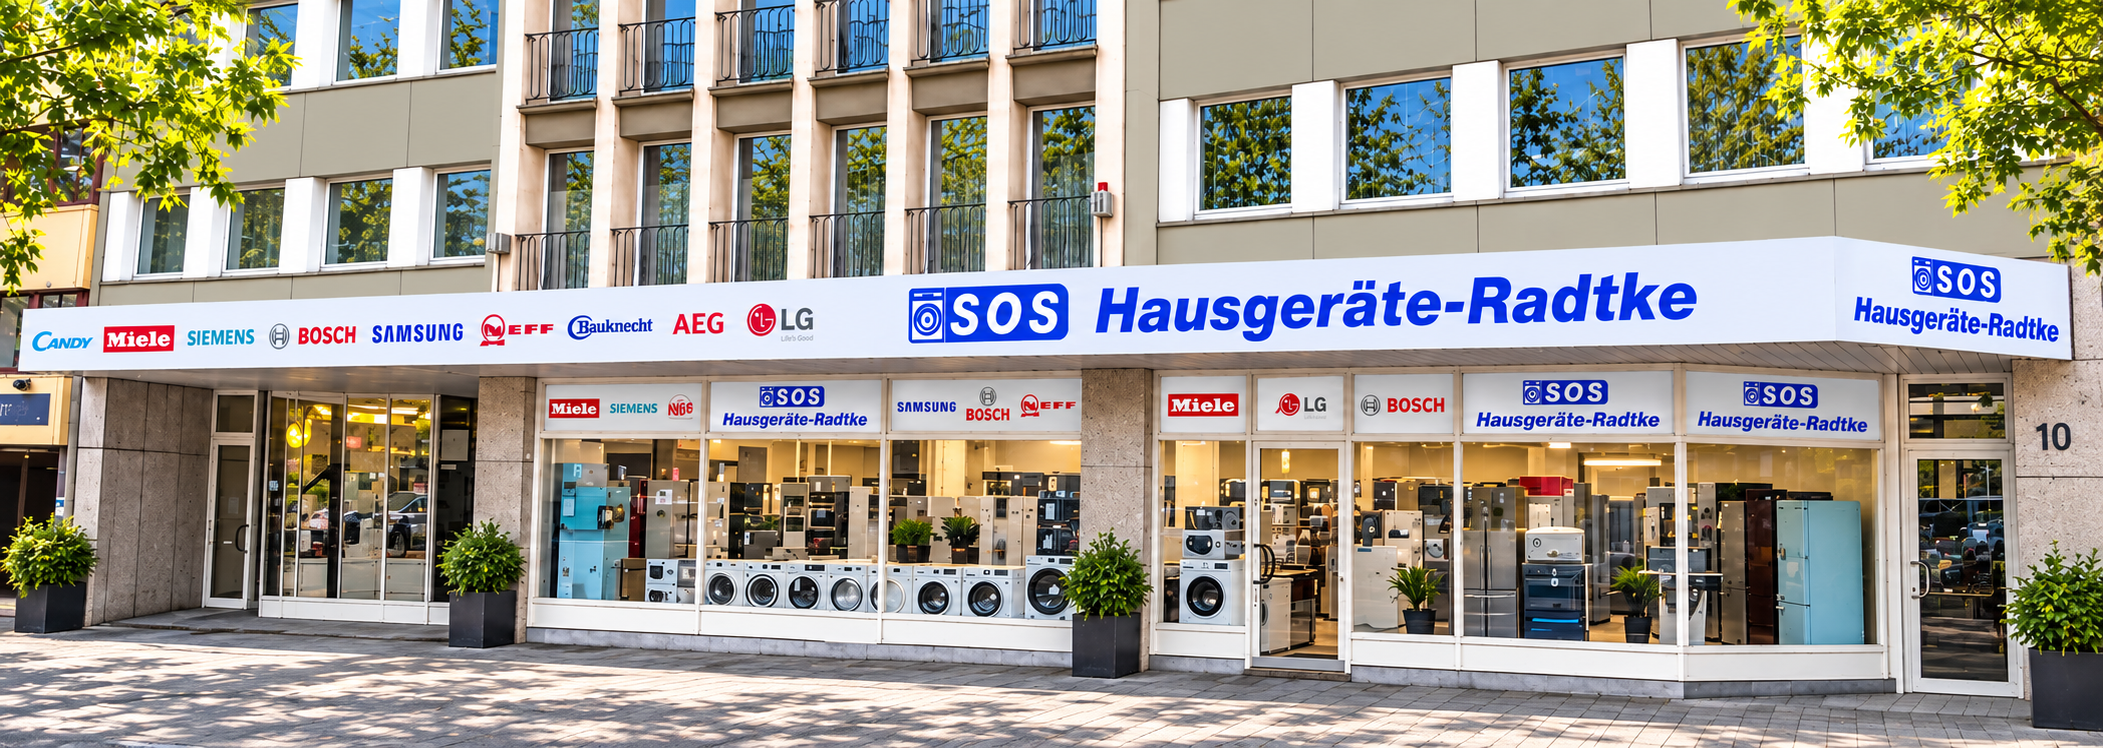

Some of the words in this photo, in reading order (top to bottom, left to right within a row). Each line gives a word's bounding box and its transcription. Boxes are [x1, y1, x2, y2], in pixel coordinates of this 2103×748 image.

[1937, 264, 1996, 299] SOS
[951, 290, 1059, 336] SOS
[1095, 272, 1698, 342] Hausgeräte-Radtke
[569, 316, 653, 338] Bauknecht
[672, 312, 725, 335] AEG
[781, 307, 814, 331] LG
[1854, 296, 2060, 343] Hausgeräte-Radtke
[107, 330, 171, 348] Miele
[187, 329, 255, 346] SIEMENS
[298, 326, 356, 345] BOSCH
[372, 323, 464, 343] SAMSUNG
[777, 387, 820, 406] SOS
[1545, 382, 1603, 403] SOS
[1762, 384, 1814, 406] SOS
[551, 402, 597, 415] Miele
[610, 403, 658, 414] SIEMENS
[897, 401, 957, 413] SAMSUNG
[1171, 398, 1235, 413] Miele
[1304, 396, 1327, 412] LG
[1387, 397, 1445, 413] BOSCH
[722, 411, 868, 430] Hausgeräte-Radtke
[966, 408, 1010, 421] BOSCH
[1476, 411, 1660, 431] Hausgeräte-Radtke
[1697, 410, 1868, 434] Hausgeräte-Radtke
[2036, 422, 2072, 451] 10
